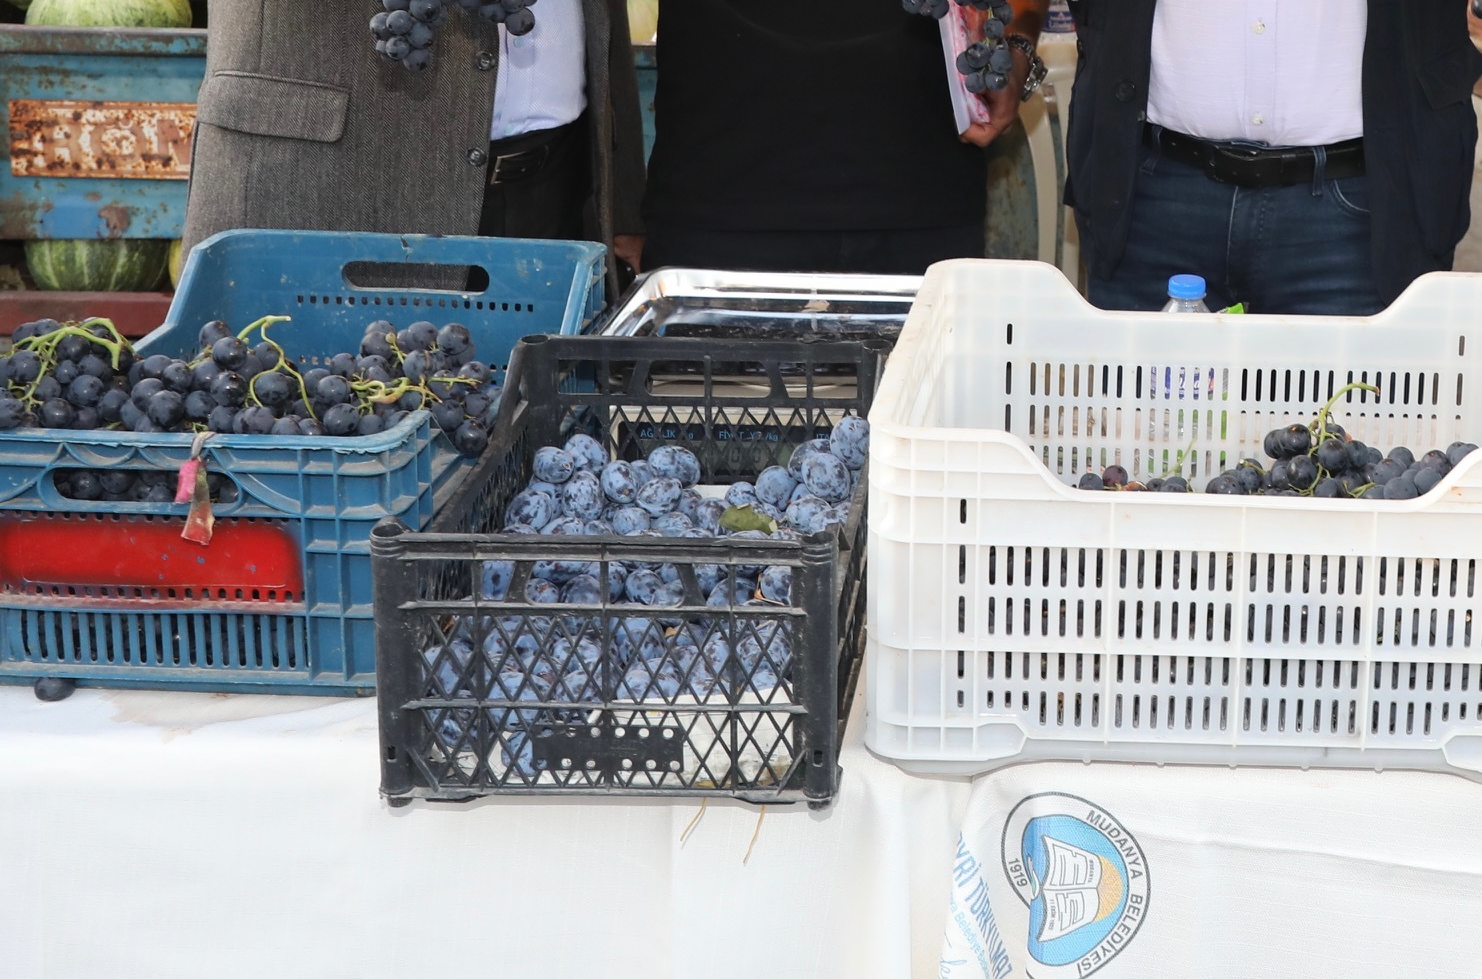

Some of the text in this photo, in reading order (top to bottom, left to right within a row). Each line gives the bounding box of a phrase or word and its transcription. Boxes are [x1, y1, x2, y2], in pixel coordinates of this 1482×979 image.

[640, 428, 676, 438] AĞLIK
[719, 430, 744, 440] FİYT
[1086, 809, 1143, 880] MUDANYA
[1008, 858, 1028, 888] 1919
